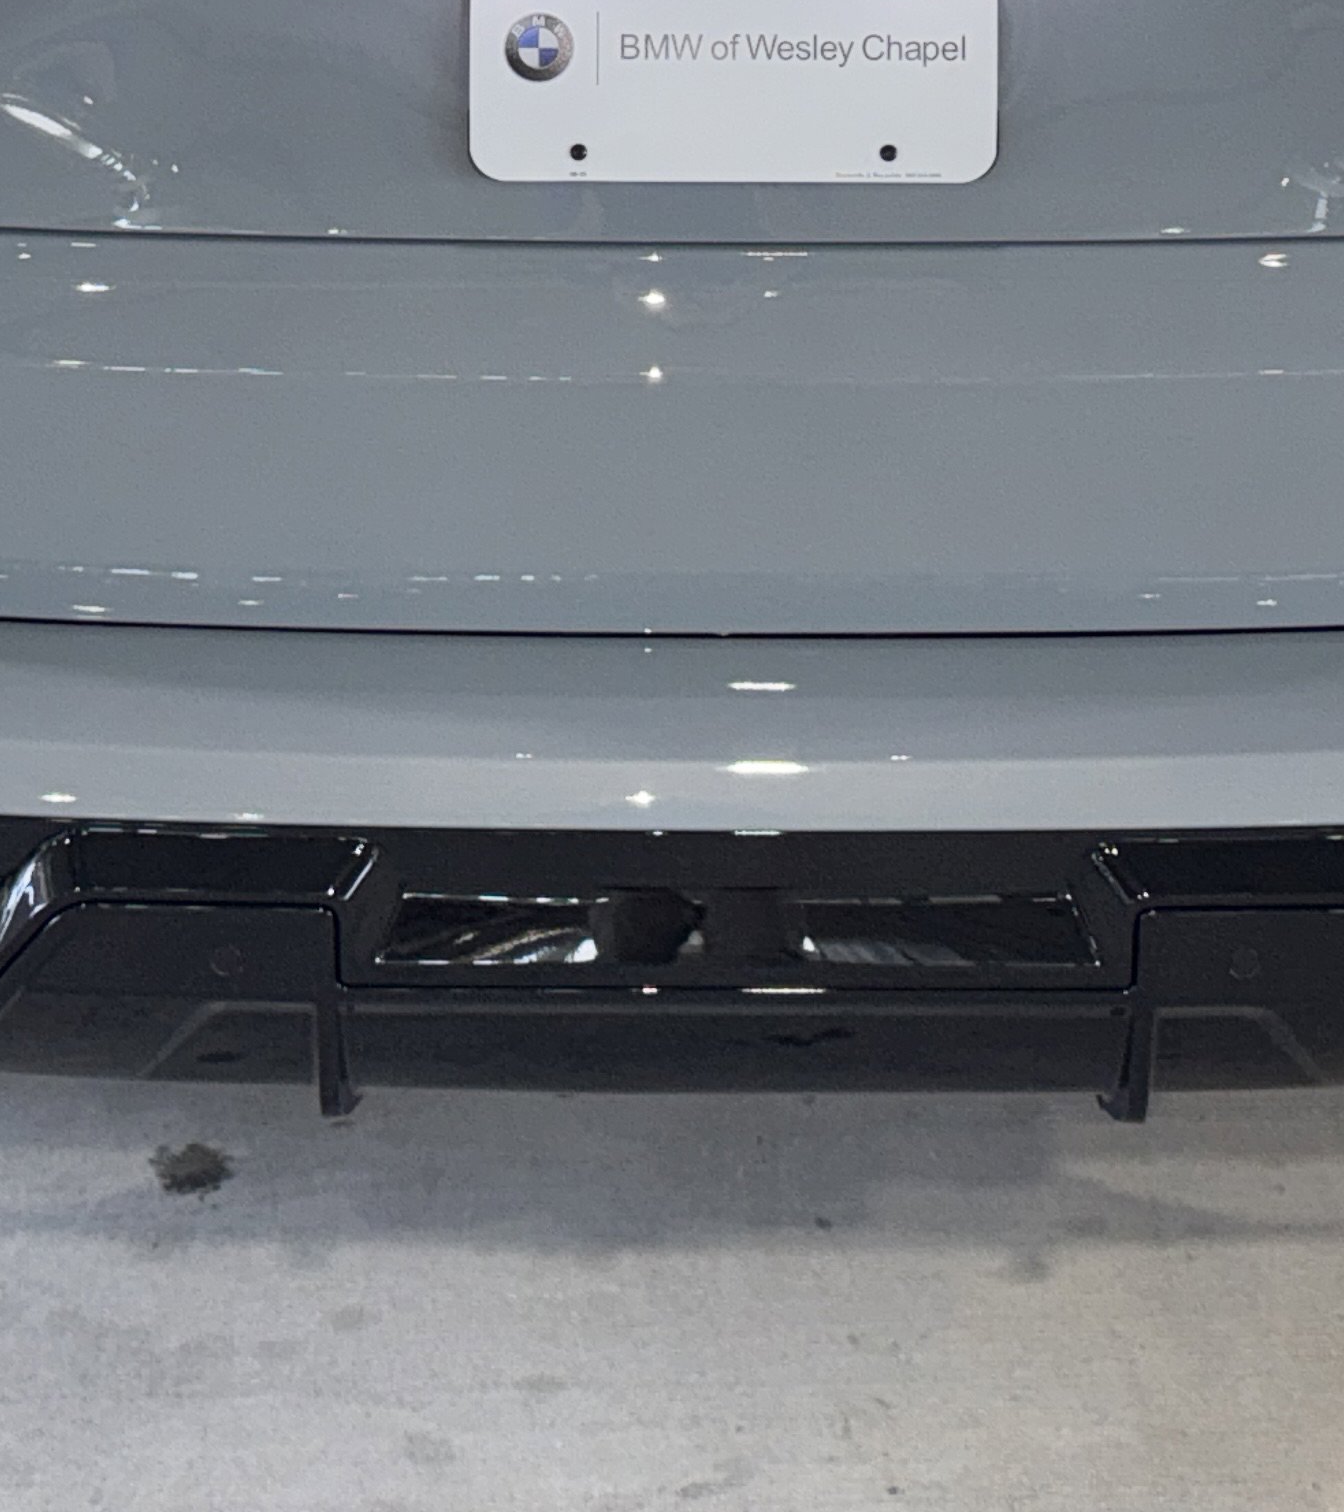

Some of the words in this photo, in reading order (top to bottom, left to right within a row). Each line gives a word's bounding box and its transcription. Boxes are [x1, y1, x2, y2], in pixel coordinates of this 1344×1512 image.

[620, 33, 702, 60] BMW
[710, 33, 741, 60] of
[748, 33, 854, 67] Wesley
[861, 33, 966, 67] Chapel
